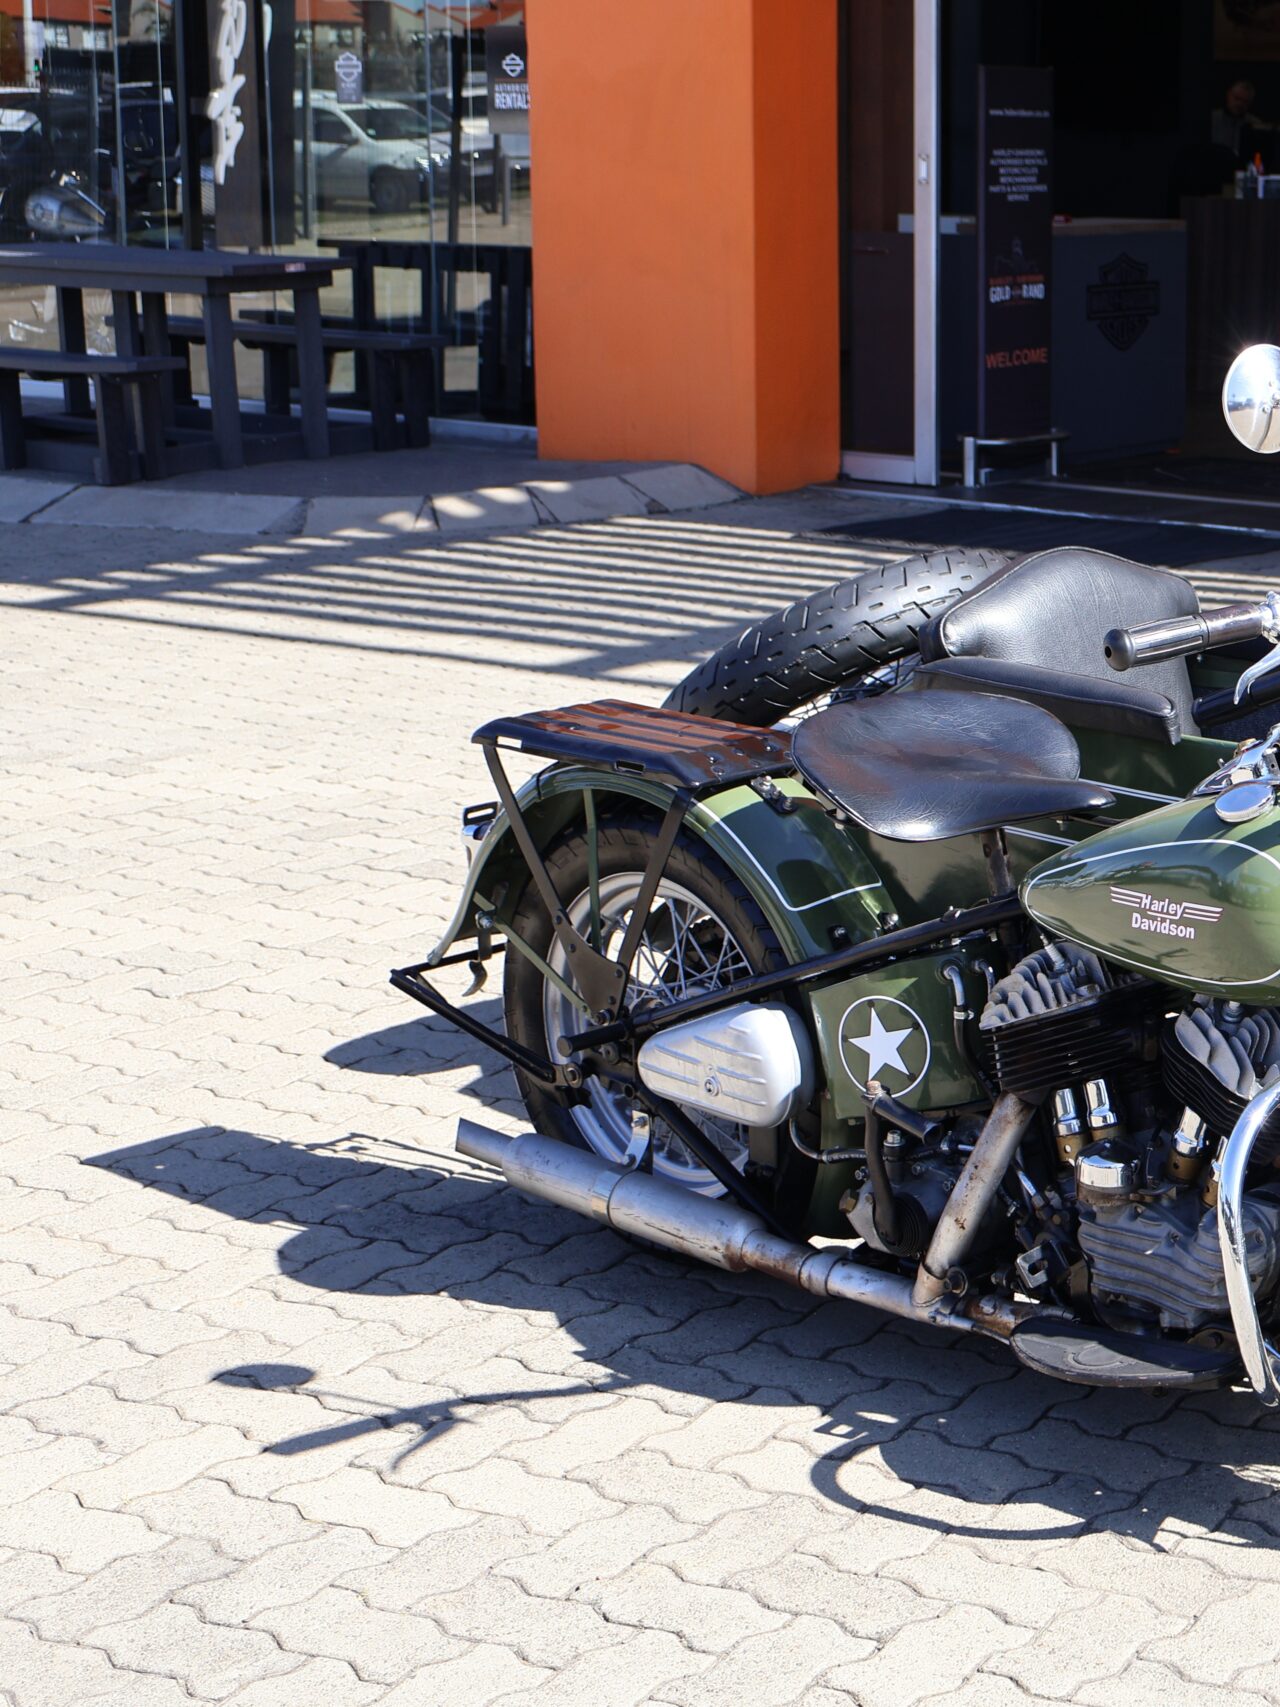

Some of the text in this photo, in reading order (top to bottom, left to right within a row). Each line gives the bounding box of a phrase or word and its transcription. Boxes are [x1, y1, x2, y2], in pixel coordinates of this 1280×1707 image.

[989, 282, 1045, 303] GOLD RAND
[985, 347, 1048, 369] WELCOME
[1140, 894, 1185, 919] Harley
[1131, 912, 1195, 939] Davidson
